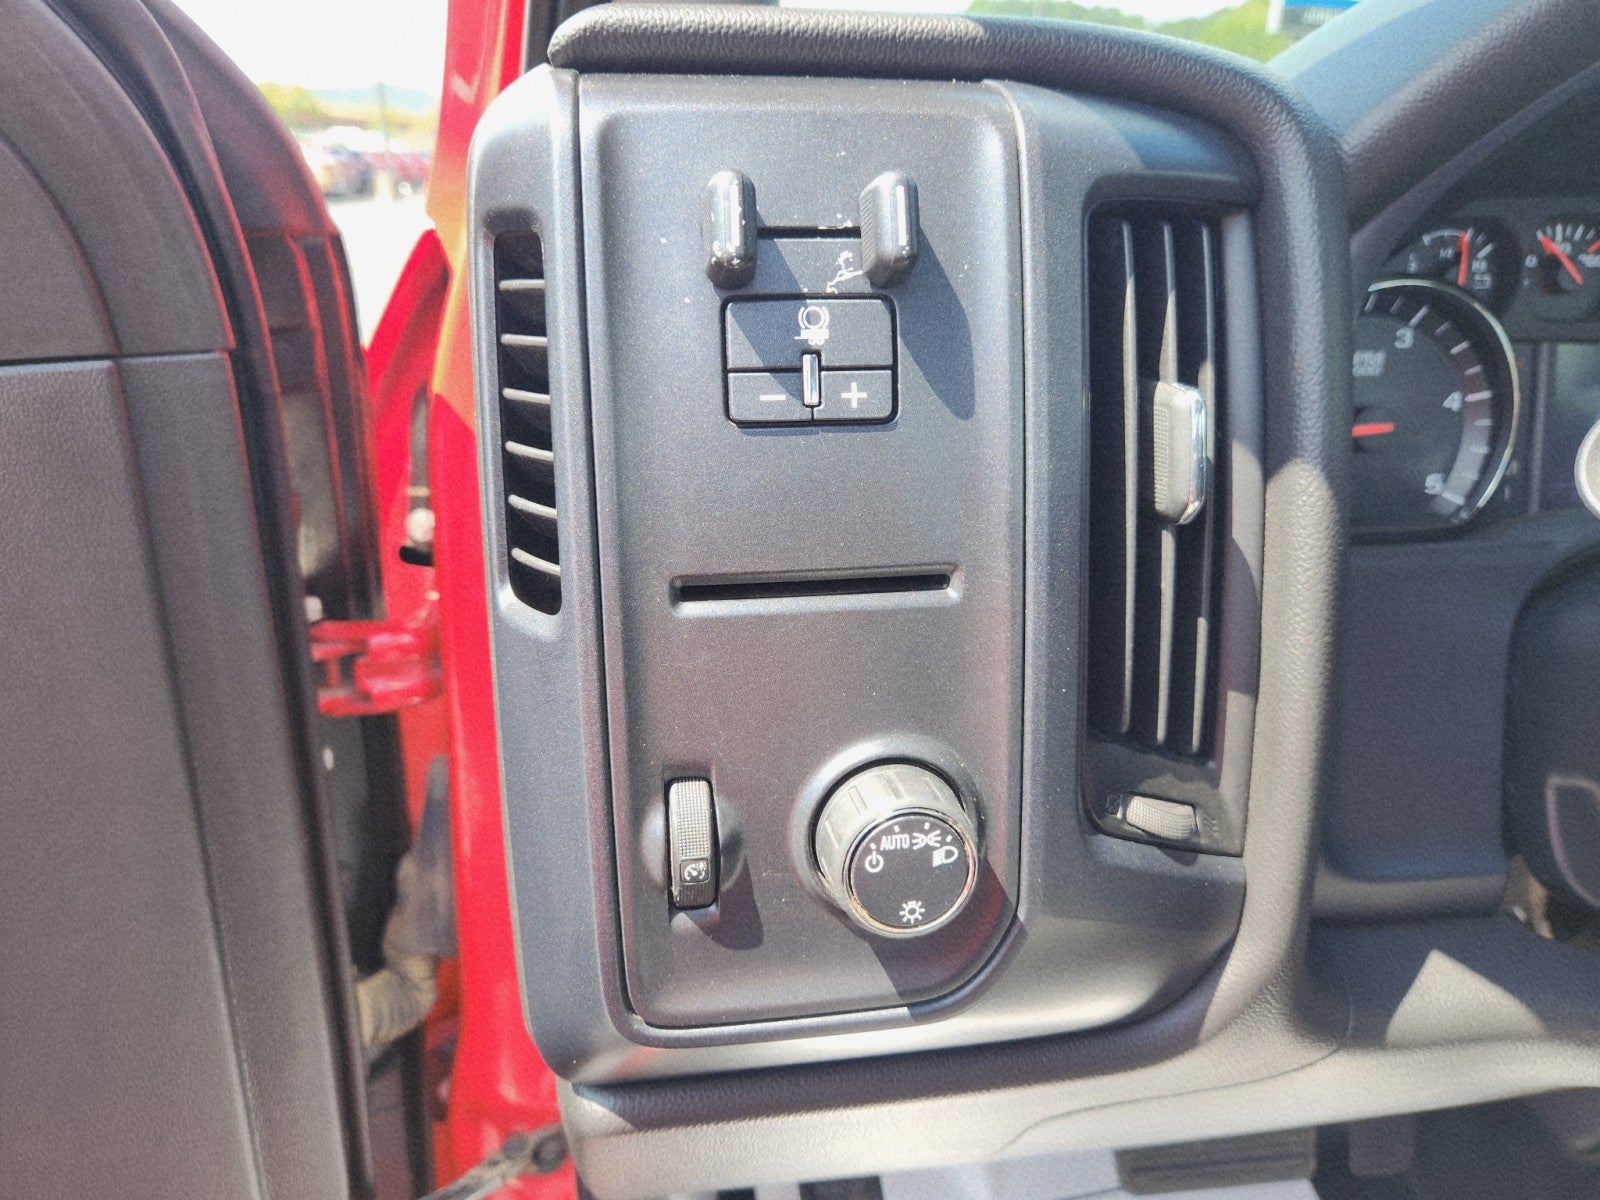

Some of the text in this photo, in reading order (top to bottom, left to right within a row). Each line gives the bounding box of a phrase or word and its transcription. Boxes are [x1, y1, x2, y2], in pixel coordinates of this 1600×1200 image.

[1394, 326, 1414, 349] 3
[1442, 390, 1463, 412] 4
[1424, 472, 1446, 496] 5
[880, 834, 911, 852] AUTO
